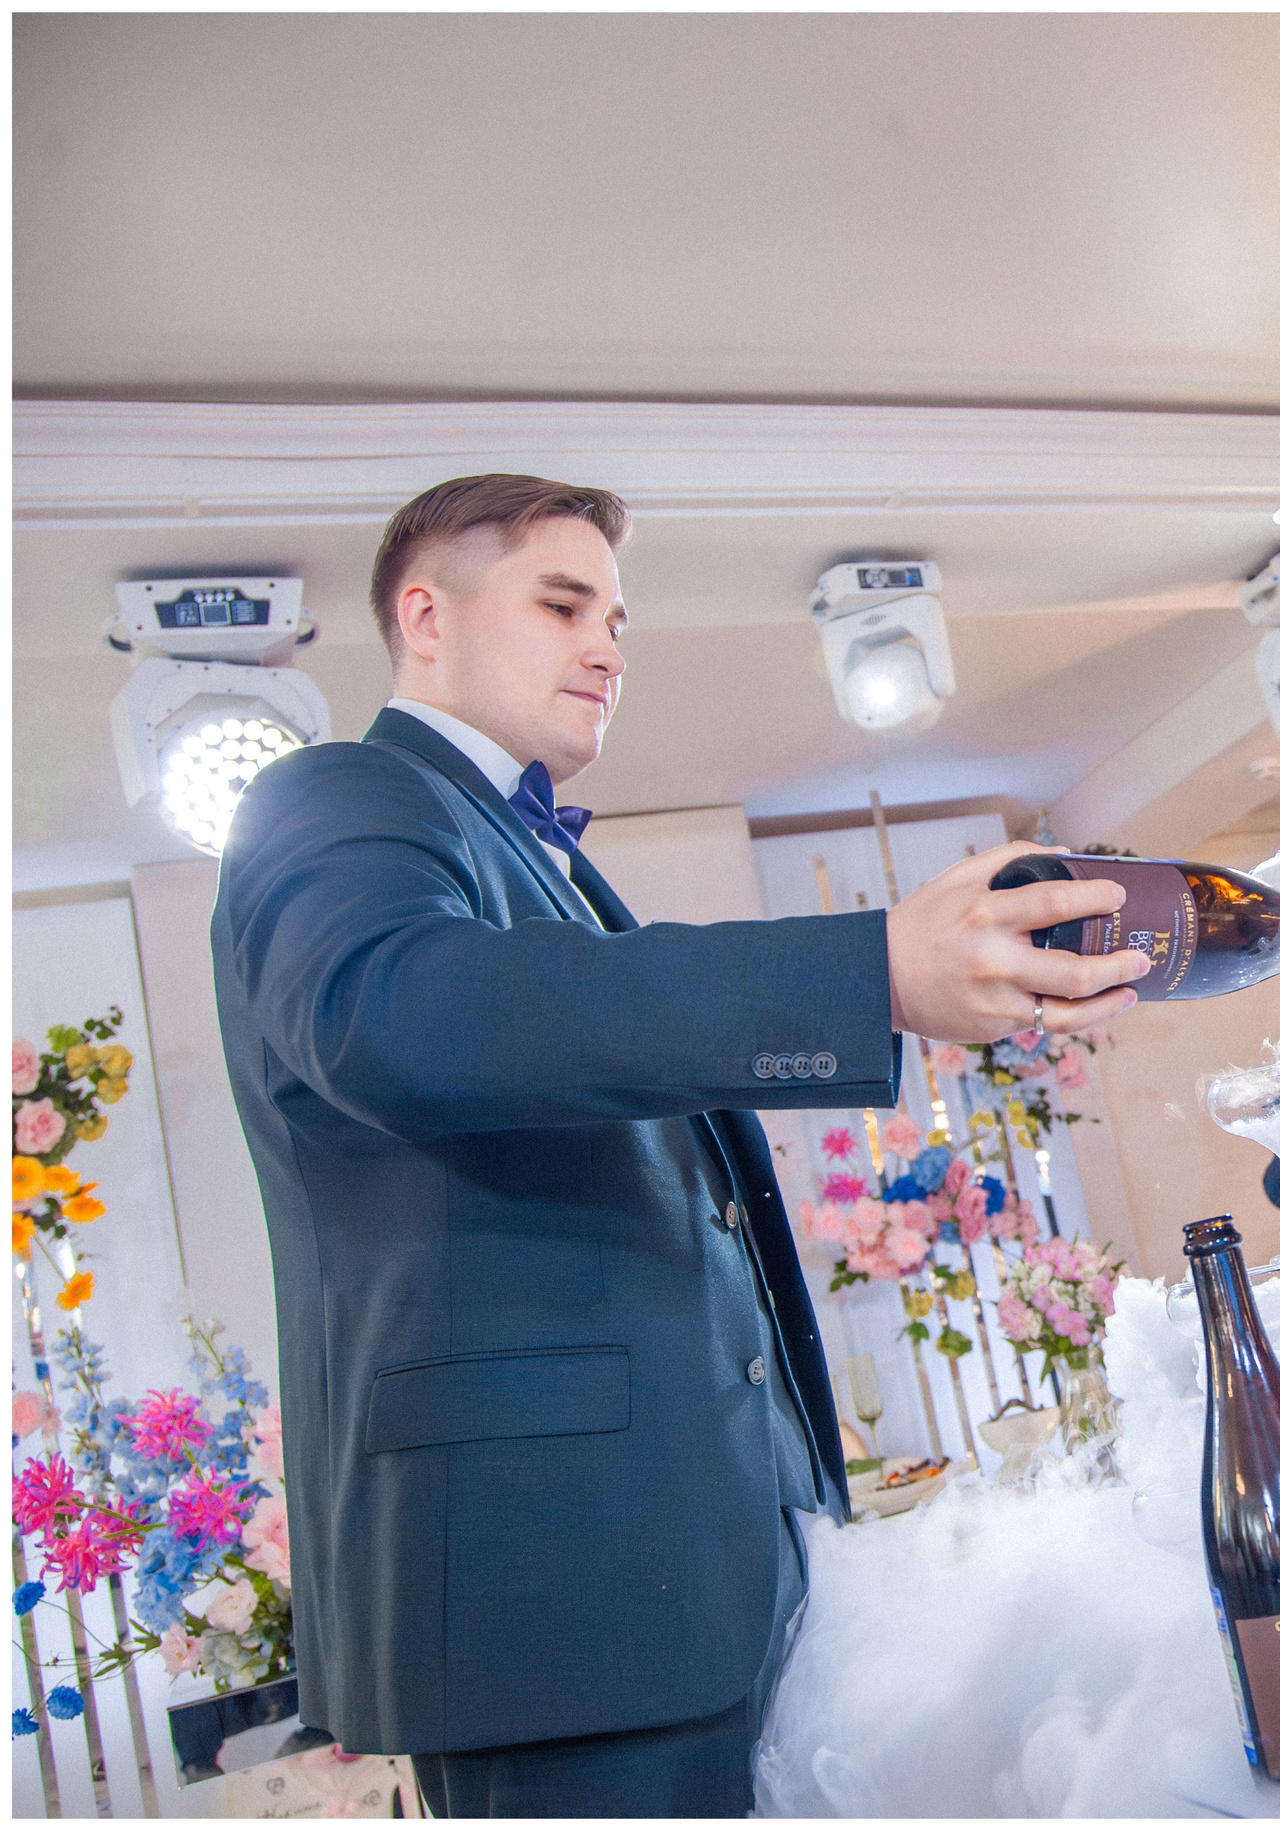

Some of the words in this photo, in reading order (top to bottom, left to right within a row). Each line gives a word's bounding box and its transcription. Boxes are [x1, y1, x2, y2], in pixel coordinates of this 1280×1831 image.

[1112, 912, 1121, 947] EXTRA
[1183, 893, 1195, 943] CRÉMANT
[1128, 931, 1139, 949] GE
[1137, 931, 1149, 952] BO
[1167, 949, 1191, 991] D'ALSACE
